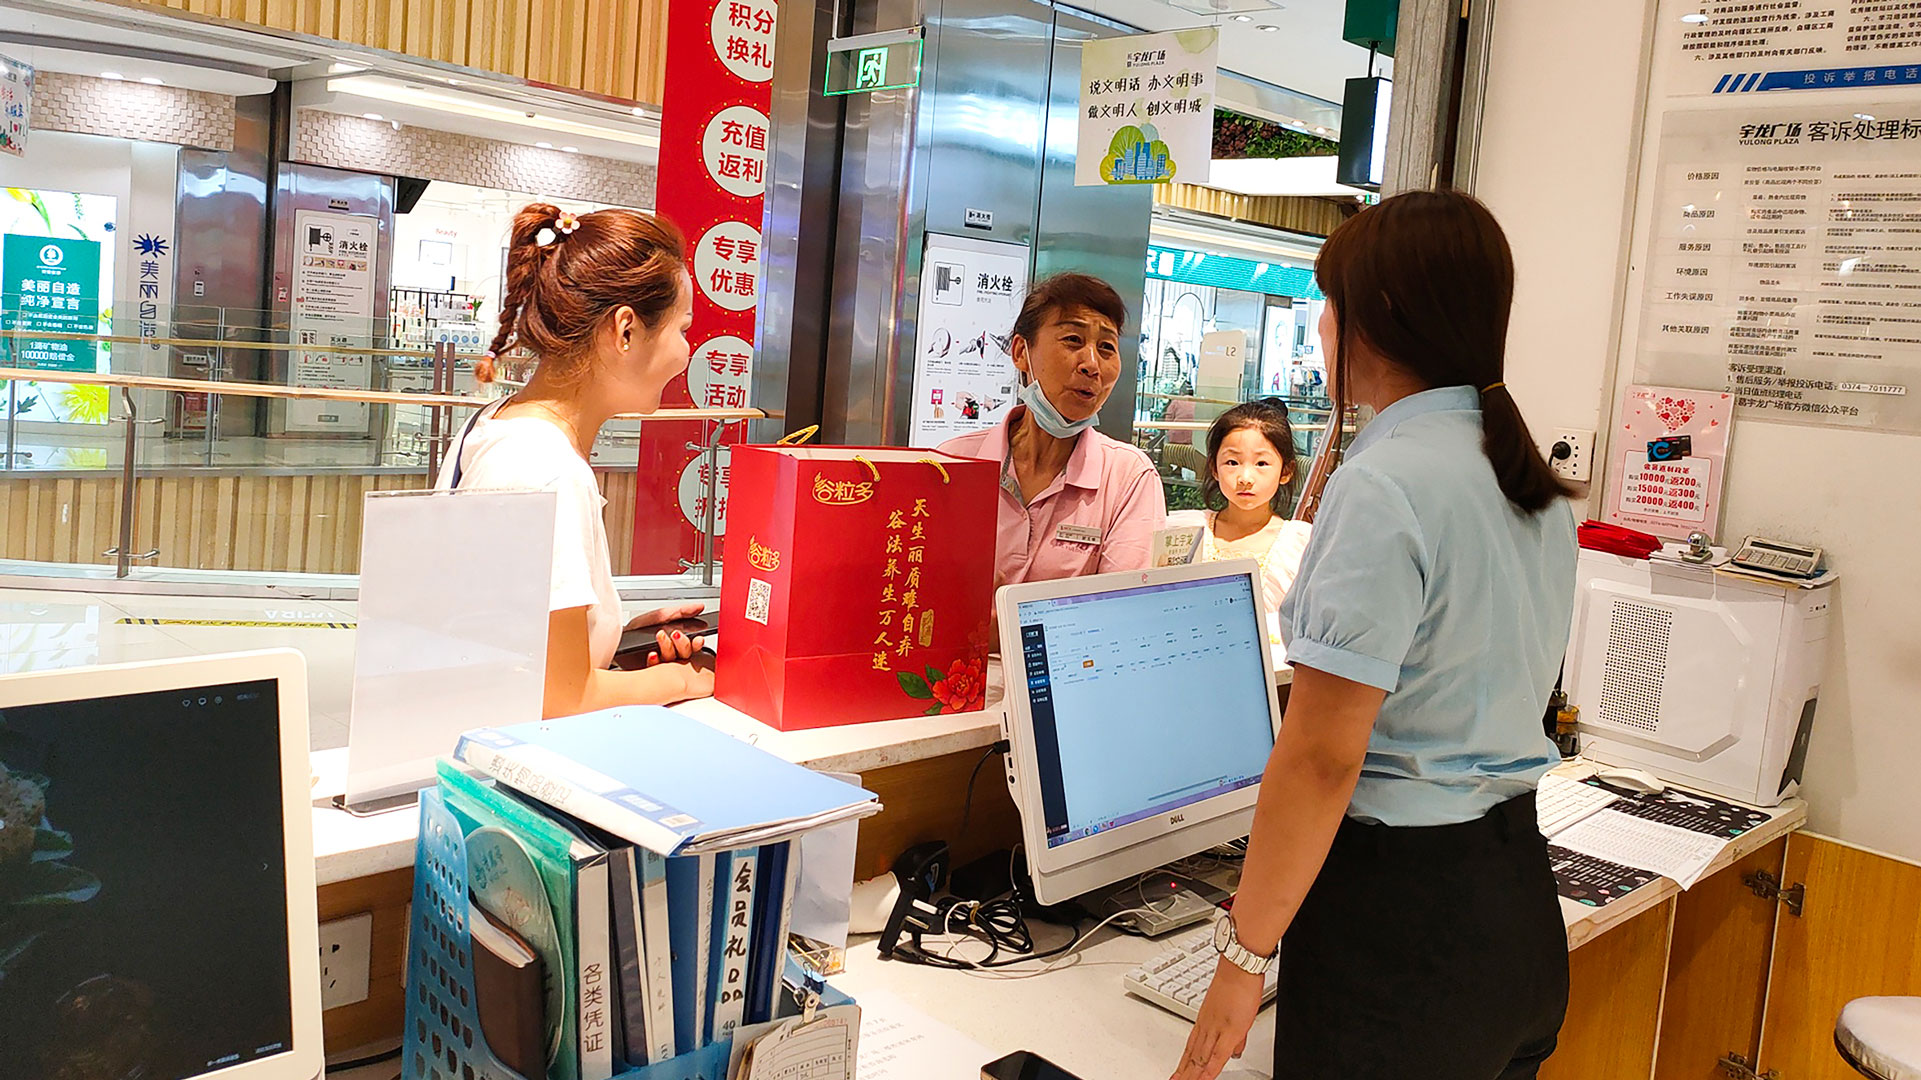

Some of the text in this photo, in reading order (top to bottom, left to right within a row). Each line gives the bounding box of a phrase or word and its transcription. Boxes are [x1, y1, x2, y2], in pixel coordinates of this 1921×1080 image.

[729, 2, 775, 34] 积分
[726, 35, 772, 69] 换礼
[1089, 72, 1203, 95] 说文明话 办文明事
[1804, 67, 1918, 84] 投诉举报电话
[1088, 98, 1202, 119] 做文明人 创文明城
[721, 120, 767, 151] 充值
[1739, 123, 1803, 138] 宇龙广场
[1739, 137, 1800, 146] YULONG PLAZA
[718, 152, 764, 184] 返利
[1687, 171, 1720, 181] 价格原因
[339, 240, 368, 252] 消火栓
[712, 234, 758, 264] 专享
[1678, 243, 1711, 252] 服务原因
[709, 267, 755, 297] 优惠
[977, 273, 1013, 292] 消火栓
[1675, 268, 1709, 277] 环境原因
[20, 278, 81, 296] 美丽自造
[1665, 291, 1714, 302] 工作失误原因
[20, 294, 81, 311] 纯净宣言
[1661, 324, 1710, 334] 其他关联原因
[706, 349, 750, 377] 专享
[704, 383, 746, 409] 活动
[1734, 399, 1860, 417] 葛宇龙广场官方微信公众平台
[812, 472, 874, 505] 谷粒多
[748, 541, 781, 571] 谷粒多
[896, 497, 931, 658] 天生丽质难自弃
[870, 510, 908, 673] 谷法养生万人迷
[1170, 813, 1185, 825] DELL
[721, 861, 752, 1005] 会员礼品
[582, 962, 605, 1053] 各类凭证
[722, 1019, 736, 1031] 40
